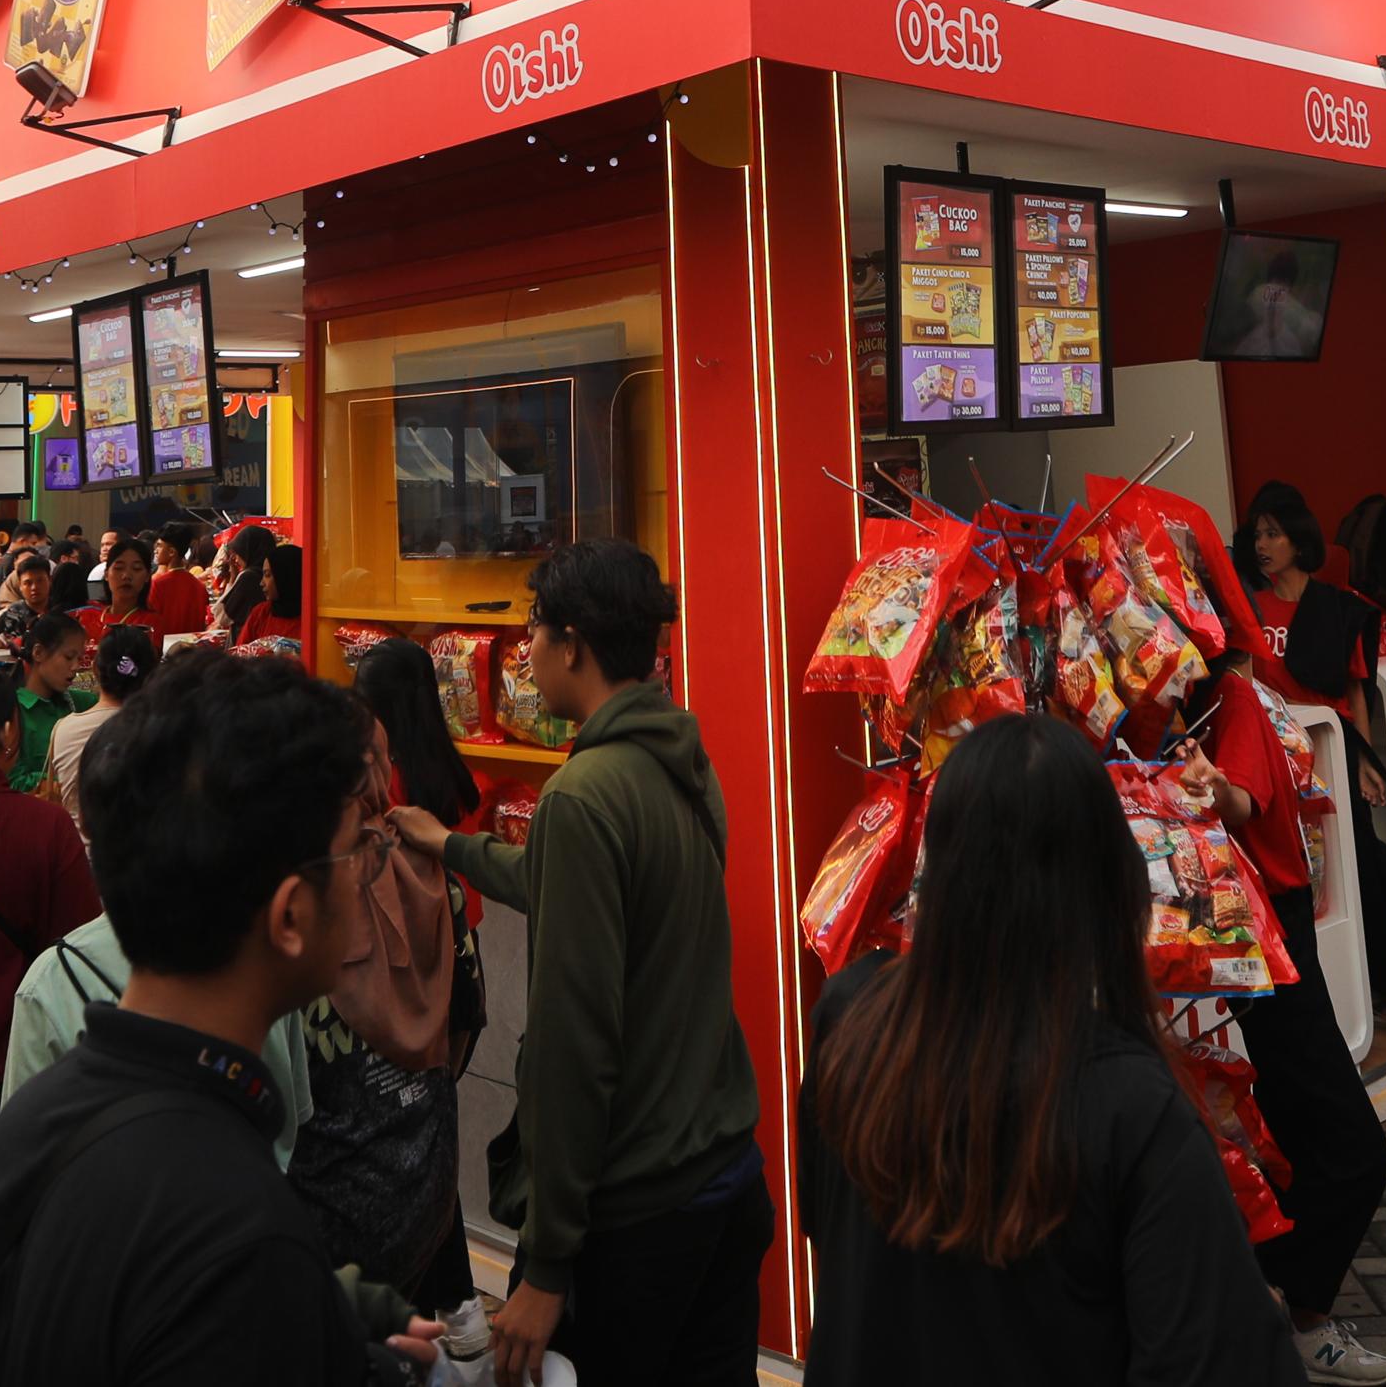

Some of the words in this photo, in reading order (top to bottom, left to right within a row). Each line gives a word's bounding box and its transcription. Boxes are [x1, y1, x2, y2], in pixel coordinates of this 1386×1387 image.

[482, 23, 583, 113] Oishi
[1304, 86, 1371, 149] Oishi
[1024, 197, 1041, 207] PAKET
[1041, 199, 1066, 210] PANCHOS
[939, 204, 978, 221] CUCKOO
[948, 219, 968, 232] BAG
[1068, 238, 1087, 247] 25,000
[1025, 254, 1042, 263] PAKET
[1042, 254, 1064, 264] PILLOWS
[1031, 262, 1052, 271] SPONGE
[911, 267, 931, 277] PAKET
[1026, 270, 1048, 279] CRUNCH
[912, 277, 938, 287] MIGGOS
[1037, 291, 1057, 300] 40,000
[1050, 309, 1067, 318] PAKET
[1067, 310, 1090, 319] POPCORN
[925, 325, 945, 335] 15,000
[912, 350, 932, 359] PAKET
[933, 349, 952, 359] TATER
[953, 349, 971, 359] THINS
[1071, 347, 1090, 356] 40,000
[1030, 366, 1048, 375] PAKET
[961, 406, 982, 415] 30,000
[1041, 403, 1061, 412] 50,000
